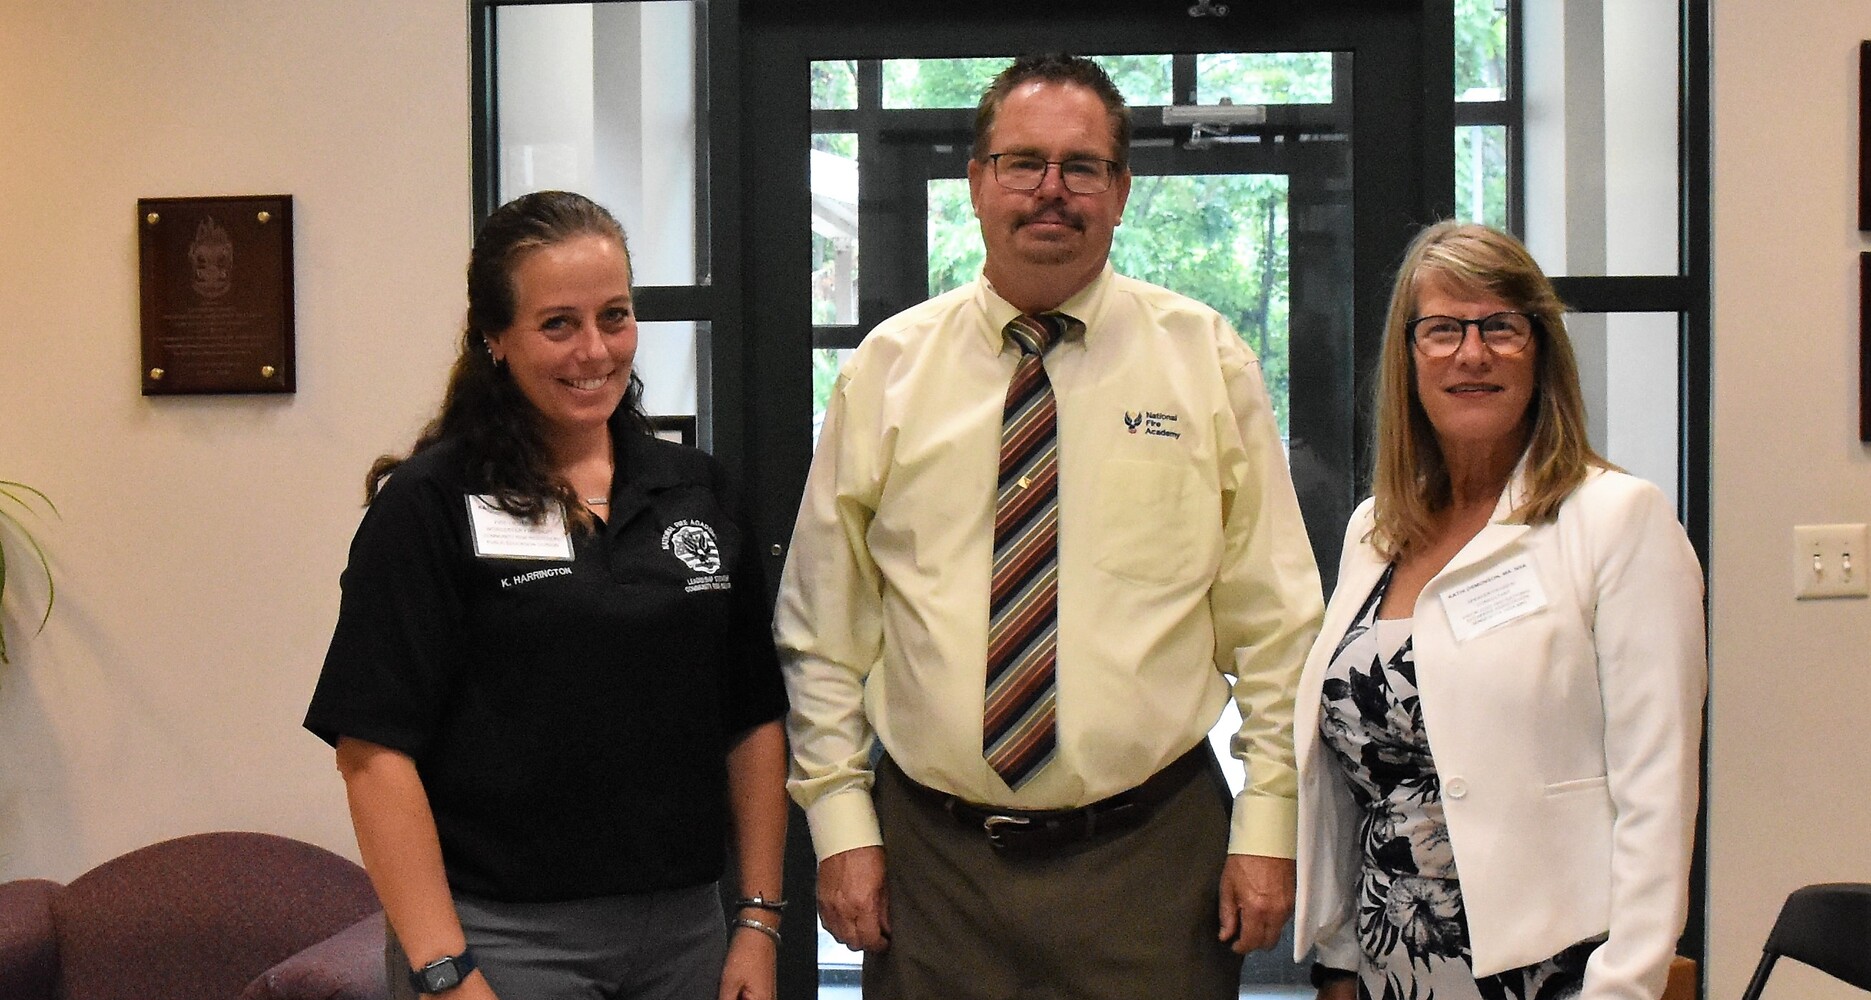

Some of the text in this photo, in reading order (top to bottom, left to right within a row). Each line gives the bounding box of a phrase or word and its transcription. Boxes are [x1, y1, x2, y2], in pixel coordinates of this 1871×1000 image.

[1146, 411, 1177, 422] National
[1146, 420, 1161, 428] Fire
[1145, 428, 1181, 440] Academy
[500, 567, 573, 588] K. HARRINGTON
